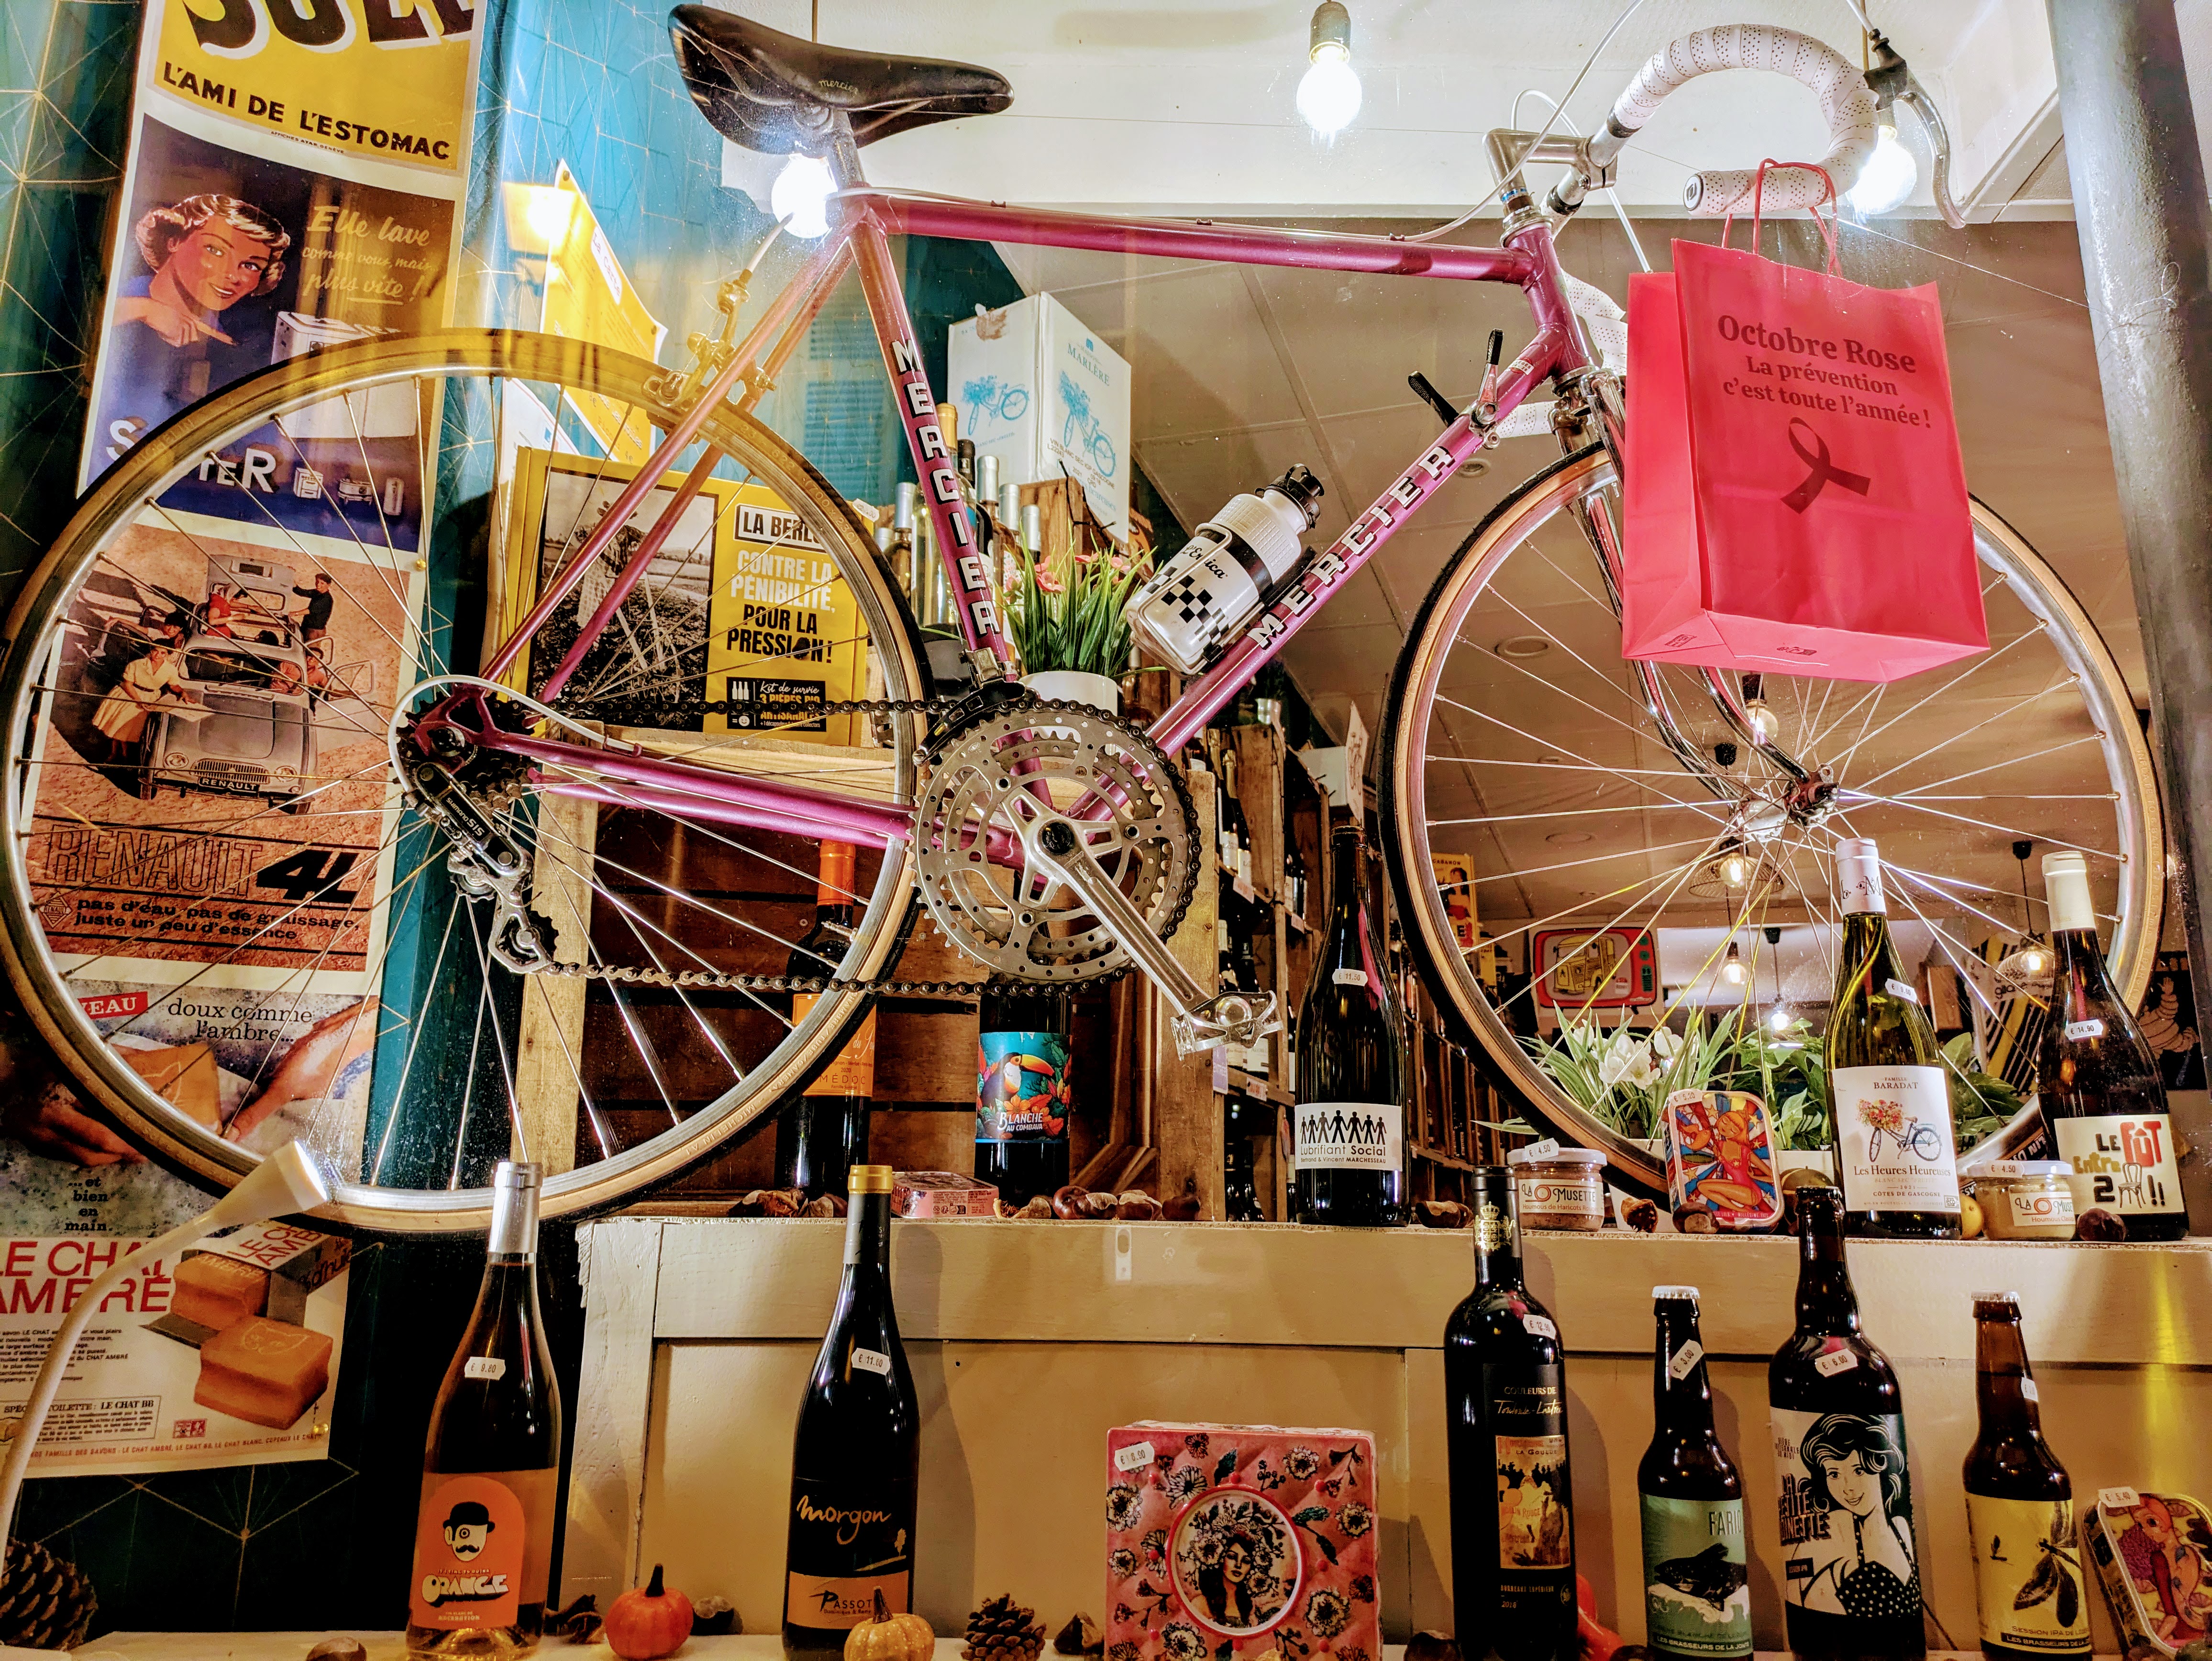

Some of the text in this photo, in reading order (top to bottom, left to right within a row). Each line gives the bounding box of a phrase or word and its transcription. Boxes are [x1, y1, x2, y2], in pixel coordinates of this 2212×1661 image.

[163, 61, 450, 160] L'AMI DE L'ESTOMAC
[271, 131, 299, 141] AFFICHES
[307, 206, 430, 246] Elle lave
[302, 247, 353, 260] comme
[302, 268, 358, 296] plus
[364, 275, 404, 298] vite
[1717, 314, 1916, 373] Octobre Rose
[1067, 343, 1110, 386] MARLÈRE
[1746, 354, 1899, 397] La prévention
[1722, 379, 1776, 403] c'est
[1780, 388, 1838, 414] toute
[1050, 438, 1115, 489] VIN BLANC SEC GASCOGNE
[892, 339, 1001, 639] MERCIER
[743, 511, 763, 535] LA
[1246, 445, 1456, 648] MERCIER
[737, 550, 832, 583] CONTRE LA
[1183, 543, 1228, 580] L'Erica
[730, 573, 835, 613] PÉNIBILITÉ,
[743, 604, 817, 635] POUR LA
[760, 681, 819, 694] Kit de survie
[202, 777, 257, 790] RENAULT
[466, 818, 485, 837] SIS
[44, 824, 359, 904] RENAULT 4L
[77, 898, 115, 912] pas
[187, 906, 221, 922] pas
[228, 907, 252, 921] de
[74, 911, 298, 940] juste un peu d'essence
[1345, 973, 1360, 981] 11.50
[168, 997, 314, 1024] doux comme
[194, 1020, 295, 1044] l'ambre...
[2077, 1024, 2095, 1033] 14.90
[852, 1033, 862, 1049] du
[819, 1073, 865, 1085] MÉDOC
[1682, 1092, 1695, 1100] 5.20
[703, 1104, 756, 1147] MICHELIN
[997, 1112, 1044, 1130] BLANCHE
[1016, 1123, 1043, 1131] COMBAVA
[1301, 1144, 1386, 1156] Lubrifiant Social
[1538, 1144, 1551, 1154] 4.50
[2095, 1120, 2162, 1167] LE FÛT
[1853, 1165, 1951, 1176] Les Heures Heureuses
[73, 1191, 108, 1203] bien
[1522, 1184, 1595, 1203] LA MUSETTE
[2093, 1175, 2115, 1202] 2
[78, 1207, 99, 1217] en
[2014, 1197, 2032, 1210] LA
[64, 1220, 112, 1232] main.
[858, 1354, 863, 1363] €
[1681, 1349, 1694, 1365] 3.00
[1821, 1353, 1848, 1371] € 6.00
[471, 1362, 497, 1374] € 9.80
[1504, 1386, 1557, 1395] COULEURS DE
[115, 1401, 139, 1409] CHAT
[1120, 1455, 1126, 1464] €
[1709, 1509, 1742, 1536] FARIO
[422, 1574, 509, 1603] ORANGE
[2012, 1626, 2048, 1636] SESSION
[1669, 1638, 1714, 1650] BRASSEURS
